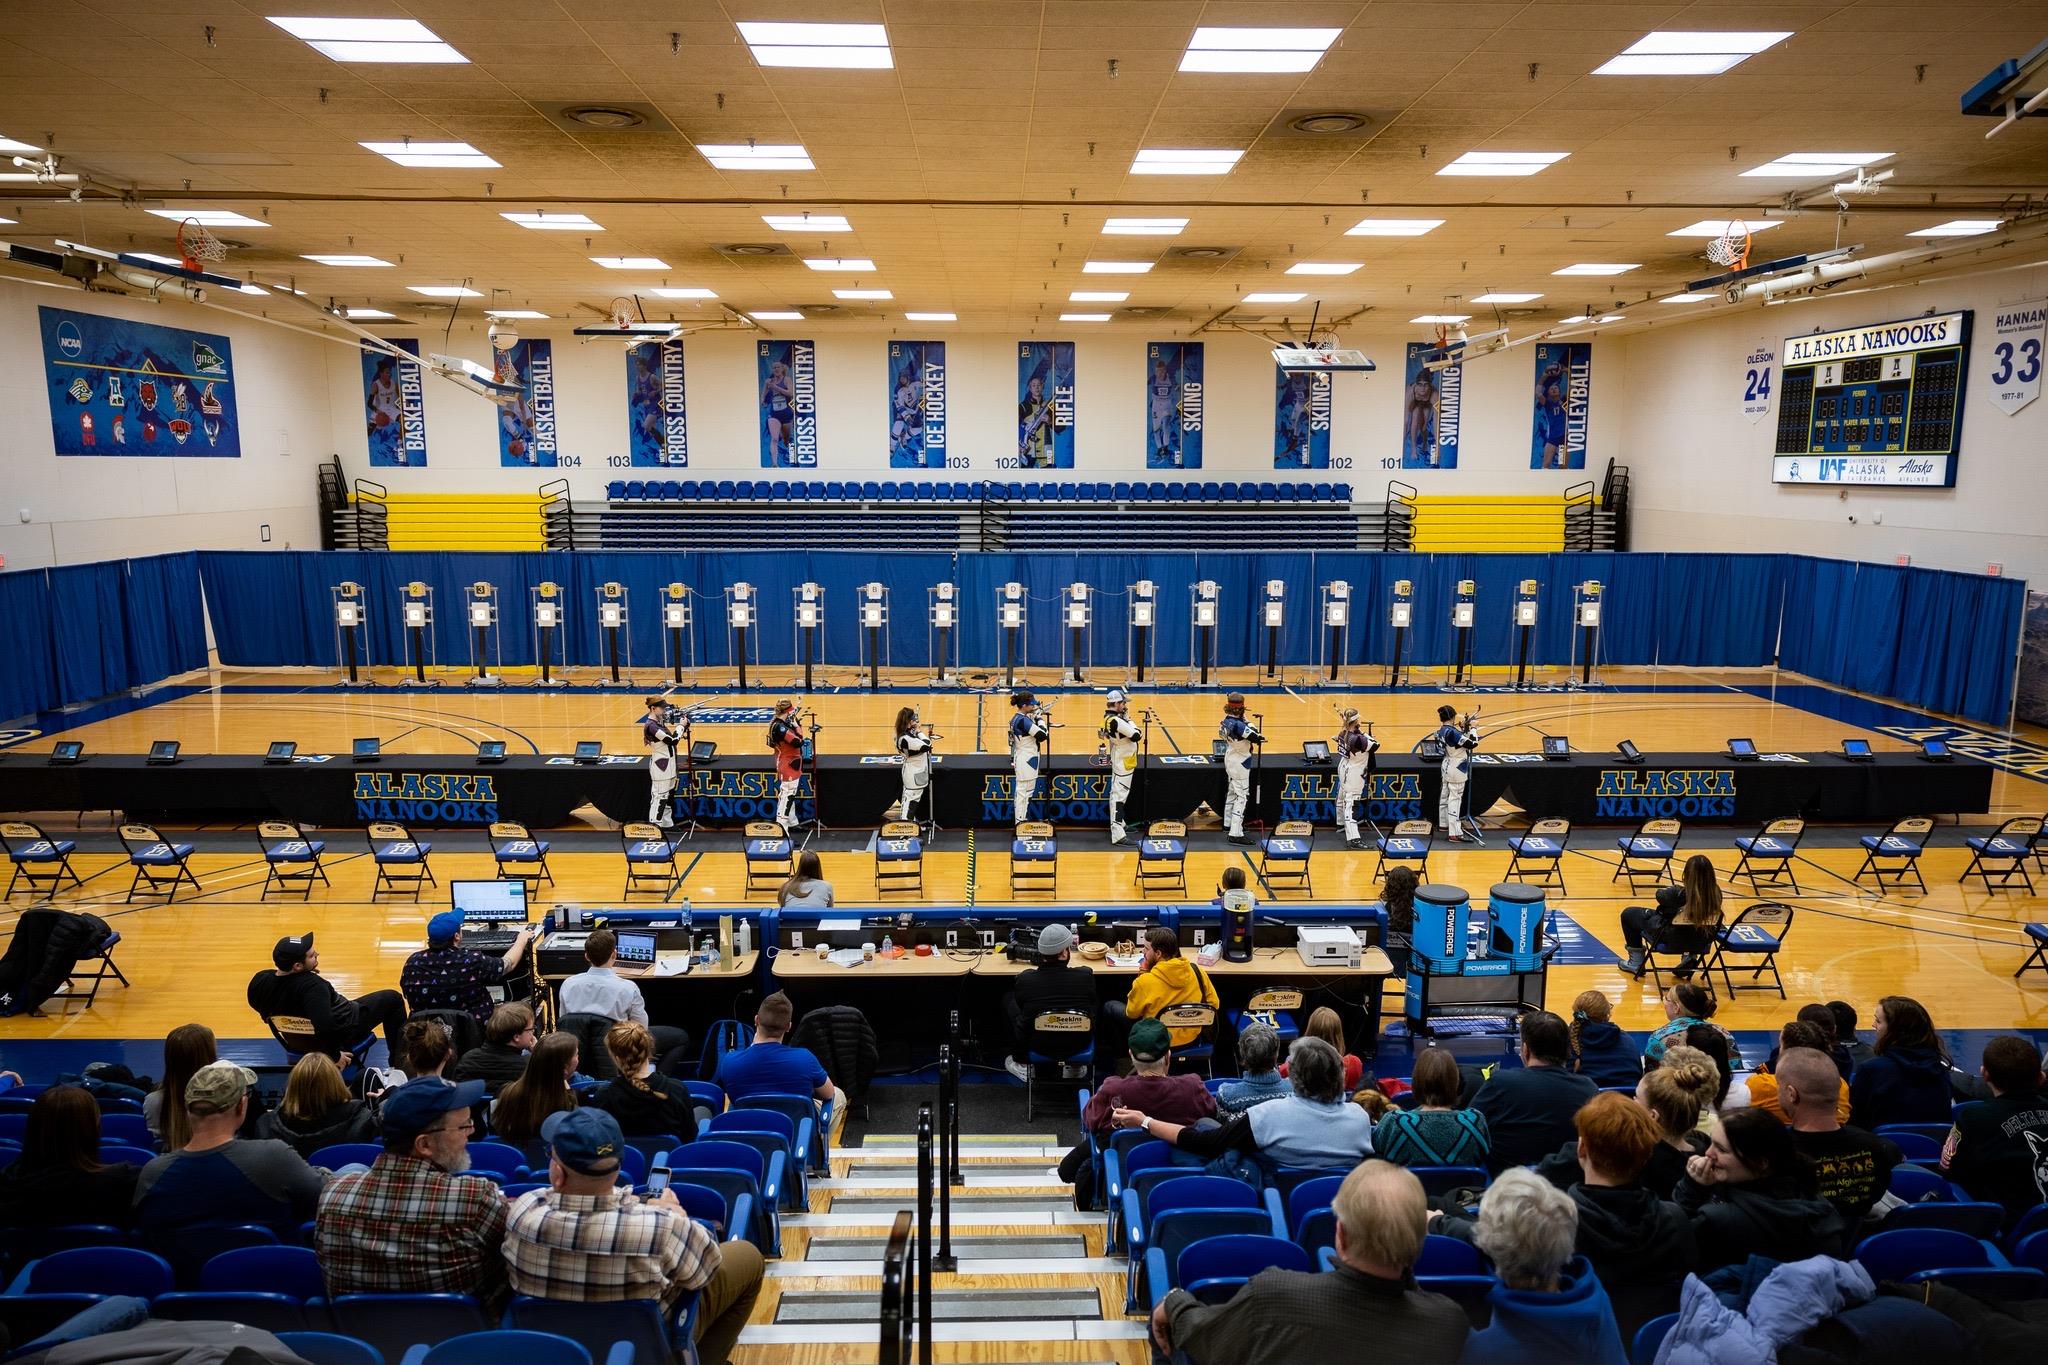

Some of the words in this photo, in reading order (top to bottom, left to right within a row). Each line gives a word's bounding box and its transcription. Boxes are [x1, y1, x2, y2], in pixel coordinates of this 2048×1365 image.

[61, 337, 81, 348] NCAA
[1793, 335, 1856, 360] ALASKA
[1861, 321, 1947, 351] NANOOKS
[196, 353, 217, 366] gnac
[1747, 353, 1774, 364] OLESON
[1992, 339, 2040, 385] 33
[664, 344, 684, 412] COUNTRY
[795, 344, 814, 413] COUNTRY
[926, 362, 945, 418] HOCKEY
[1744, 367, 1771, 402] 24
[534, 356, 556, 452] BASKETBALL
[1055, 385, 1073, 426] RIFLE
[1183, 382, 1202, 432] SKIING
[1311, 380, 1330, 431] SKIING
[1440, 367, 1461, 446] SWIMMING
[1567, 360, 1590, 453] VOLLEYBALL
[2001, 392, 2024, 401] 1977-81
[666, 414, 687, 465] CROSS
[796, 415, 816, 466] CROSS
[927, 421, 945, 449] ICE
[558, 456, 581, 467] 104
[607, 456, 630, 467] 103
[947, 457, 970, 468] 103
[995, 457, 1018, 469] 102
[1329, 457, 1352, 469] 102
[1381, 457, 1401, 469] 101
[1819, 458, 1848, 481] UAF
[1848, 465, 1886, 475] ALASKA
[1898, 458, 1934, 475] Alaska
[354, 772, 497, 801] ALASKA
[1596, 771, 1736, 796] ALASKA
[356, 800, 498, 822] NANOOKS
[674, 798, 816, 818] NANOOS
[1596, 796, 1735, 818] NANOOKS
[1446, 908, 1455, 955] POWERADE
[1519, 907, 1528, 954] POWERADE
[1466, 963, 1508, 972] POWERADE
[2001, 1110, 2041, 1138] DELTA
